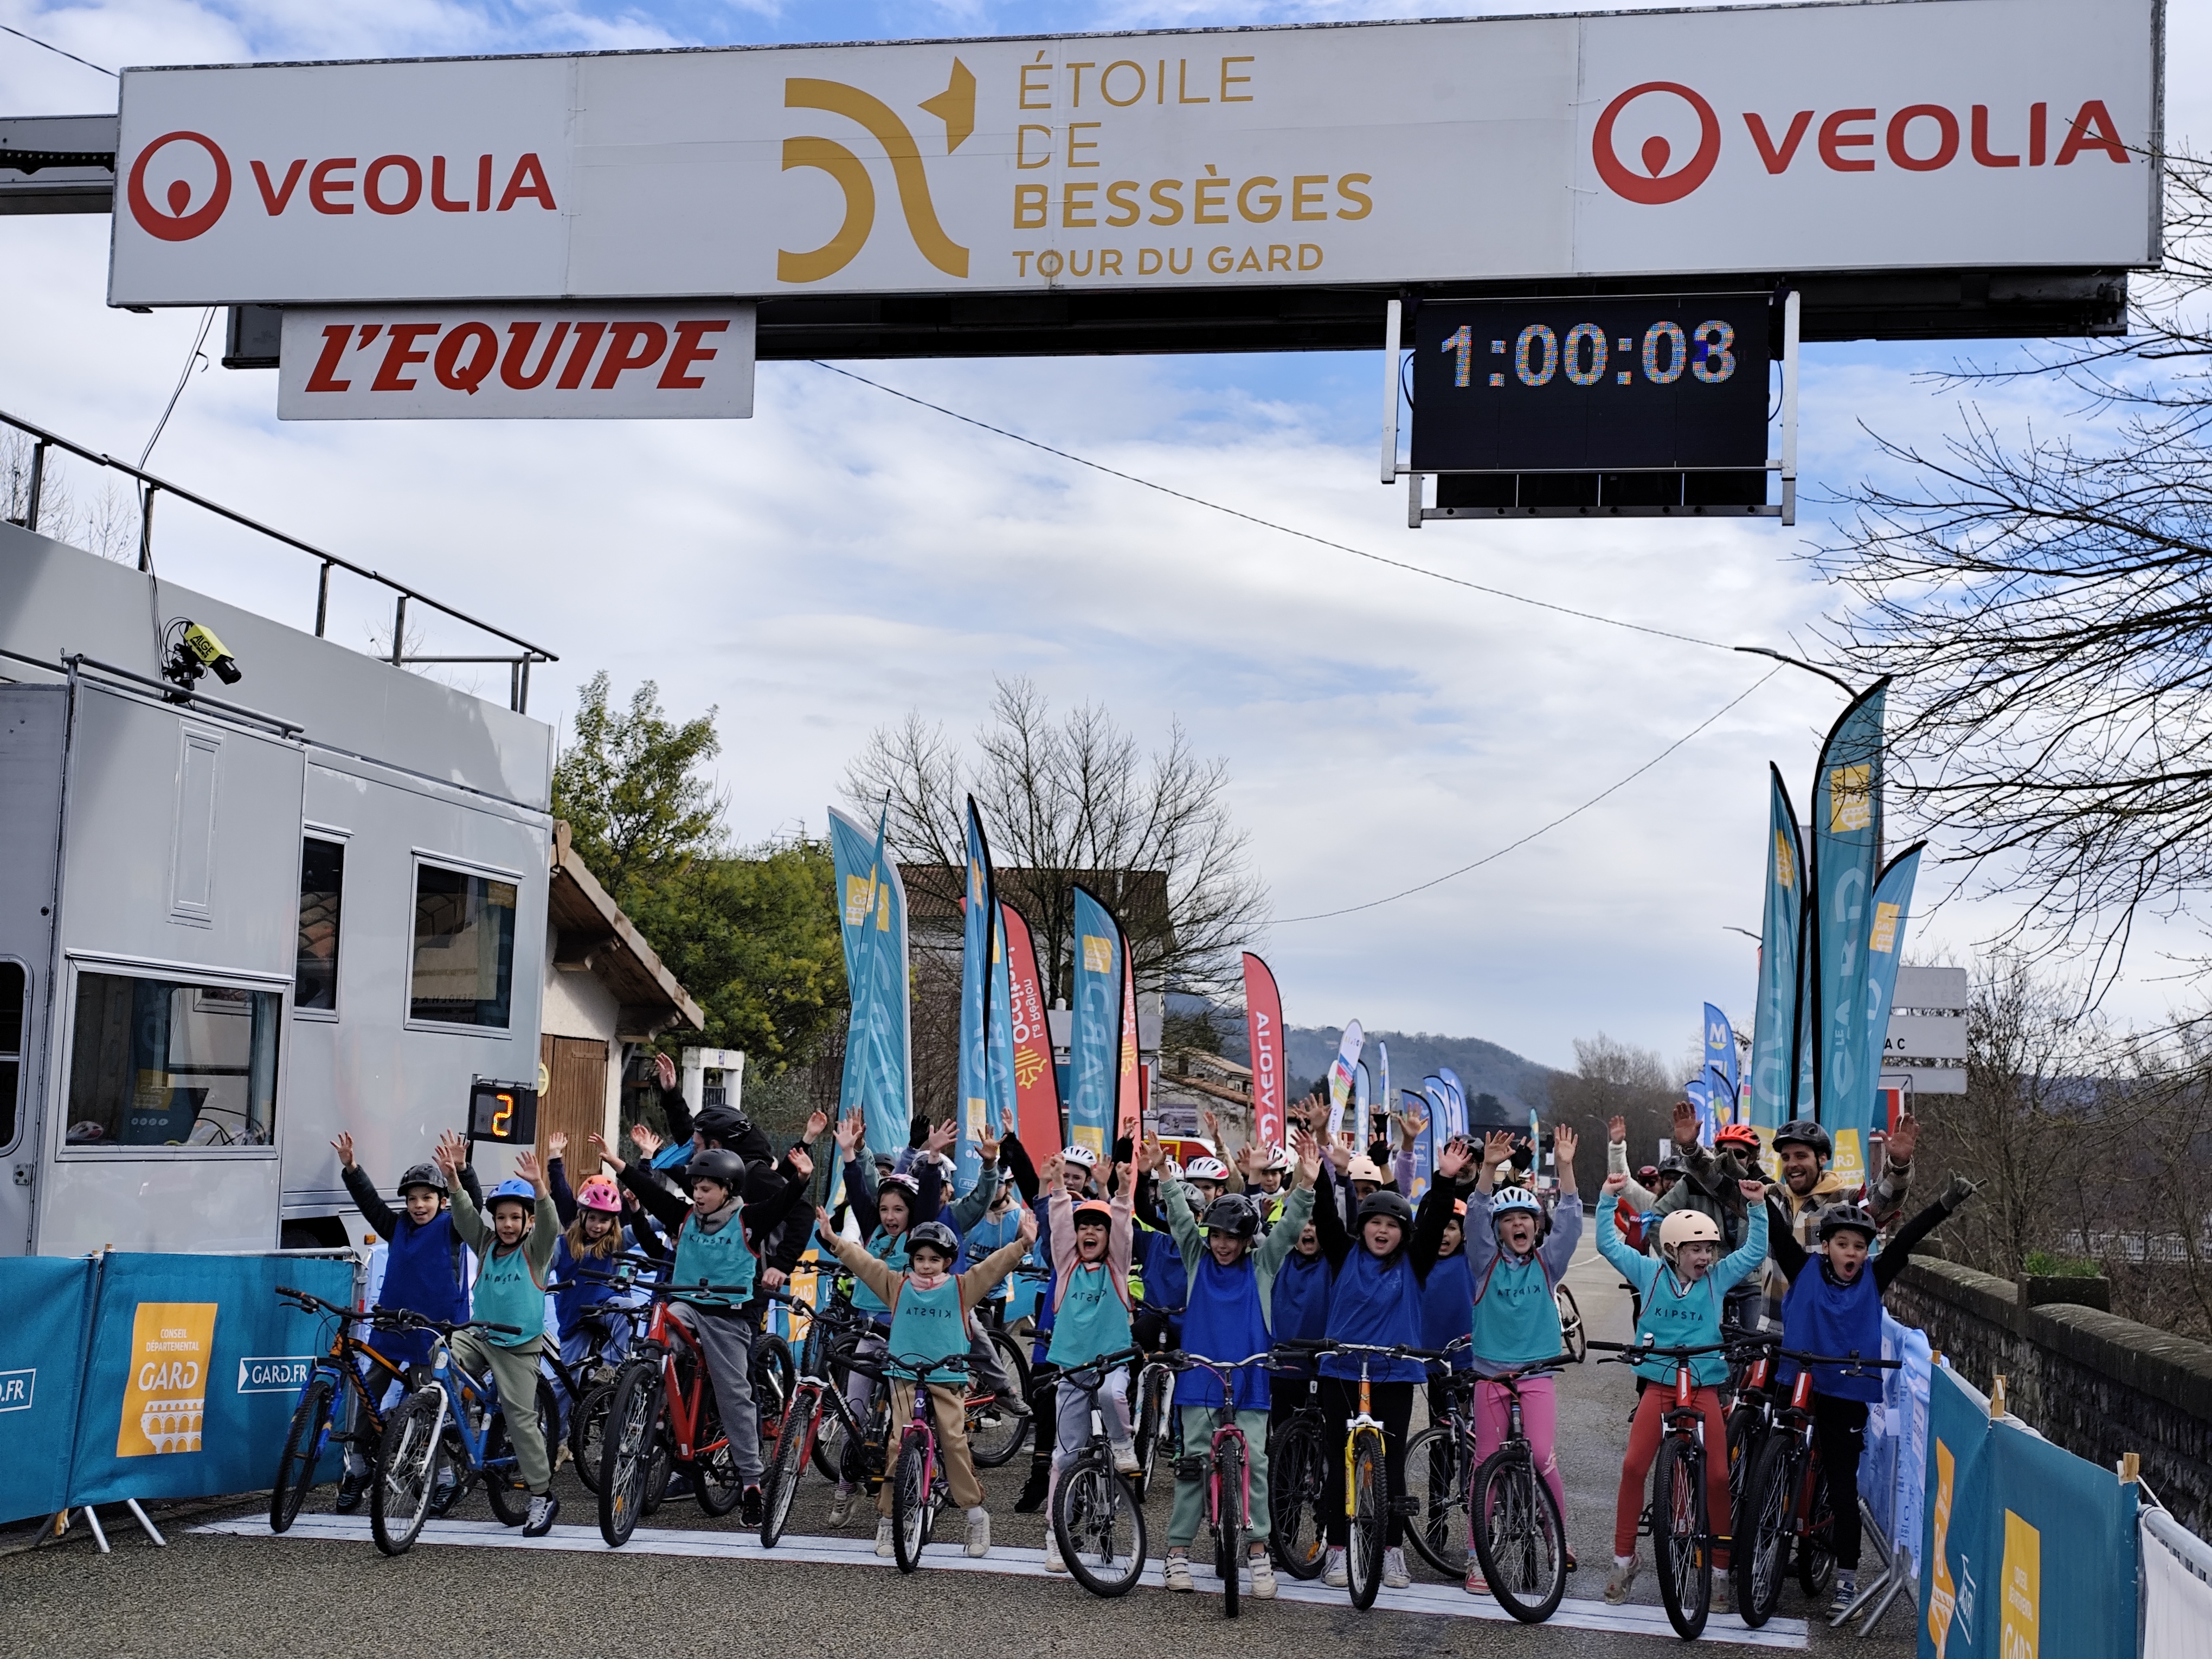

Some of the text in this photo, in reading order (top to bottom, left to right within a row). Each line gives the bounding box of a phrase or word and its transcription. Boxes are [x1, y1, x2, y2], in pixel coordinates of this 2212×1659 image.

[1019, 50, 1255, 110] ÉTOILE
[1017, 121, 1102, 170] DE
[1742, 99, 2131, 175] VEOLIA
[249, 152, 558, 216] VEOLIA
[1013, 164, 1374, 229] BESSÈGES
[1012, 243, 1324, 278] TOUR DU GARD
[304, 320, 731, 396] L'EQUIPE
[192, 635, 215, 656] ALGE
[492, 1094, 513, 1137] 2
[1654, 1307, 1703, 1321] KIPSTA
[146, 1340, 200, 1352] DÉPARTEMENTAL
[160, 1328, 188, 1339] CONSEIL
[0, 1379, 24, 1403] .FR
[138, 1361, 200, 1391] GARD
[252, 1364, 307, 1384] GARD.FR
